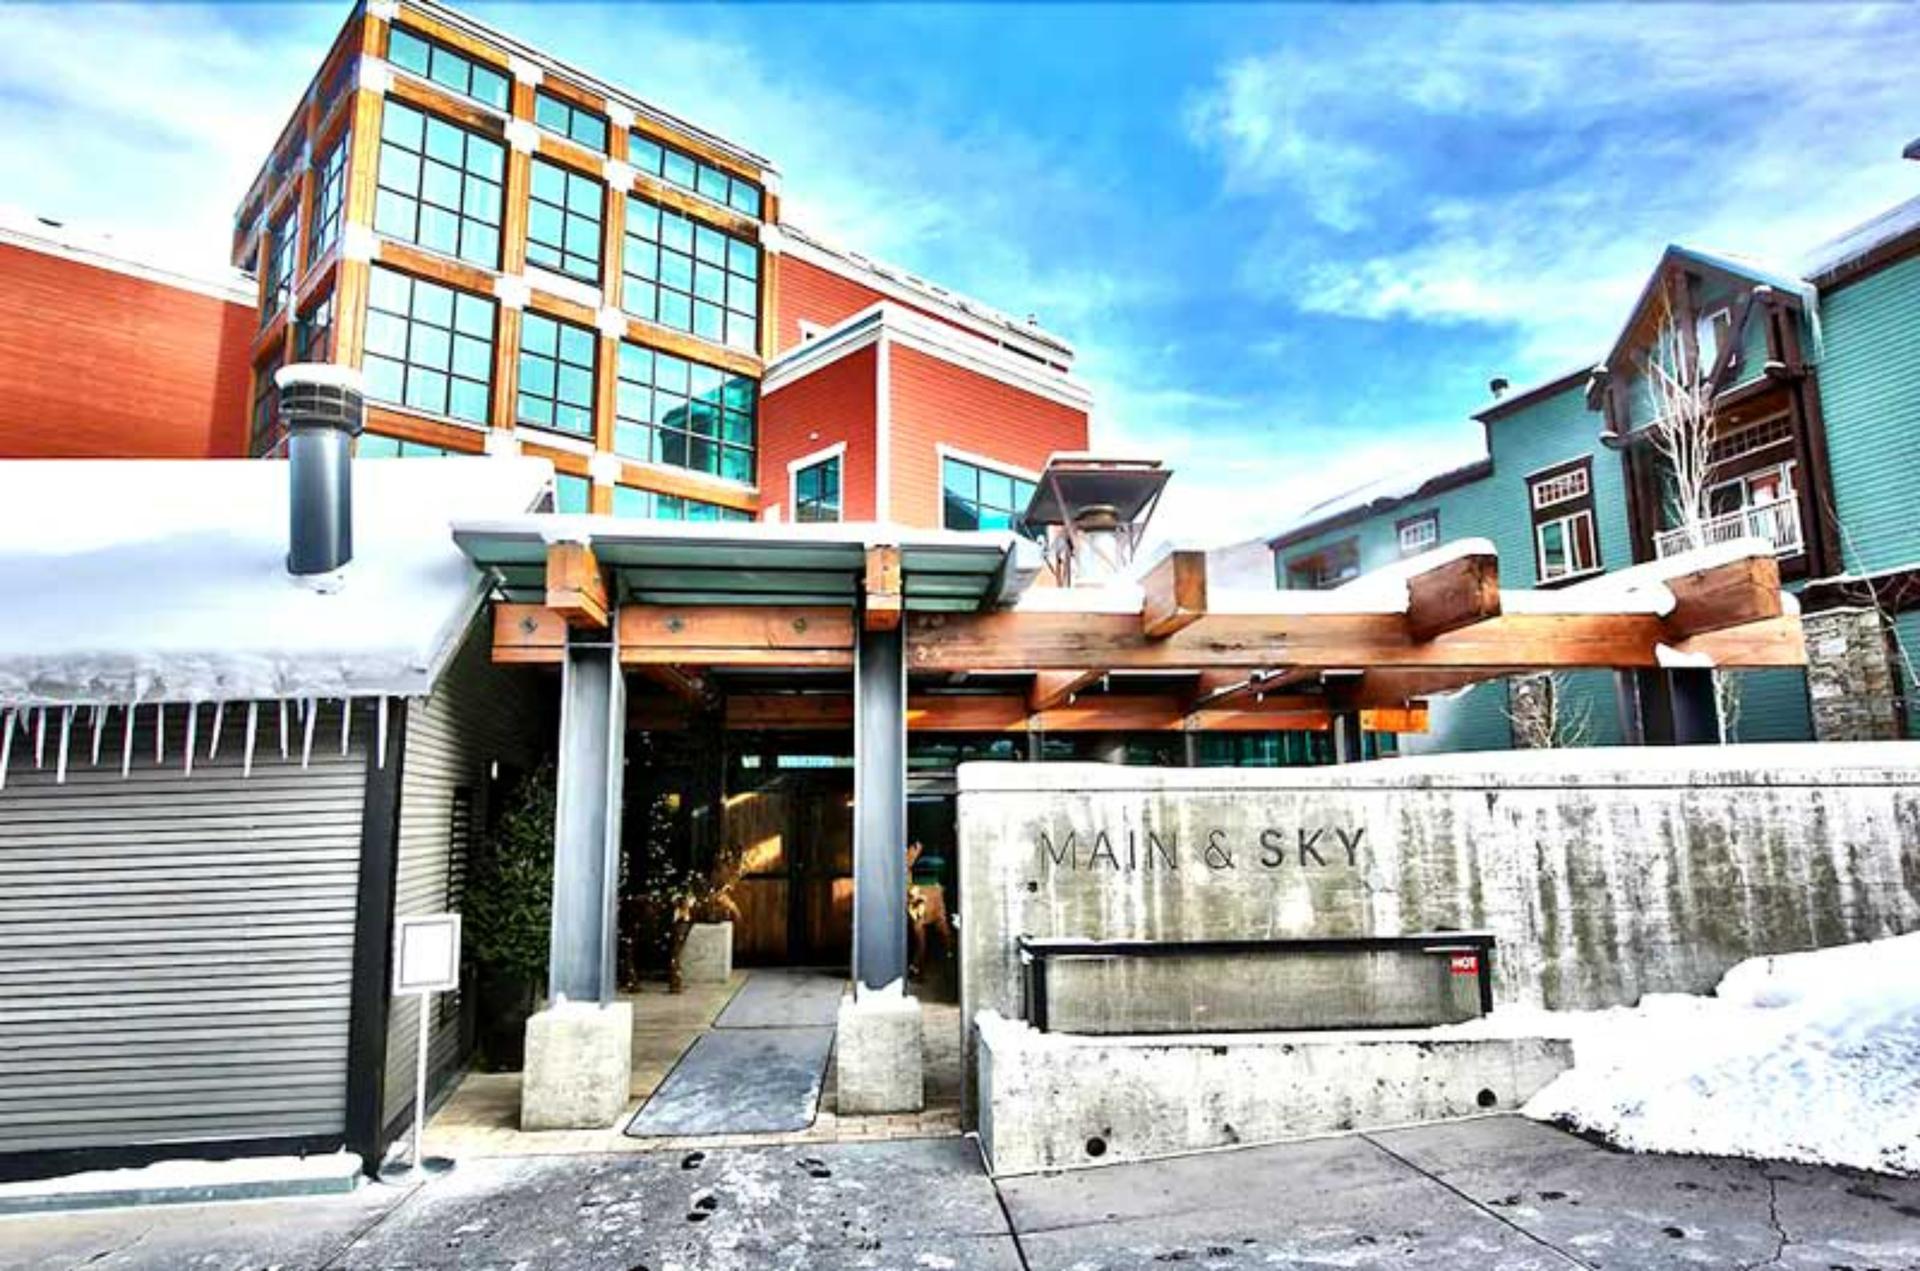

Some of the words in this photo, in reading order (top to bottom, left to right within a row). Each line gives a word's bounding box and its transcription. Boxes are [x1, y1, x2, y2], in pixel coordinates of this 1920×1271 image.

[1040, 829, 1178, 872] MAIN
[1204, 829, 1236, 869] &
[1260, 827, 1365, 868] SKY
[1451, 956, 1477, 969] HOT
